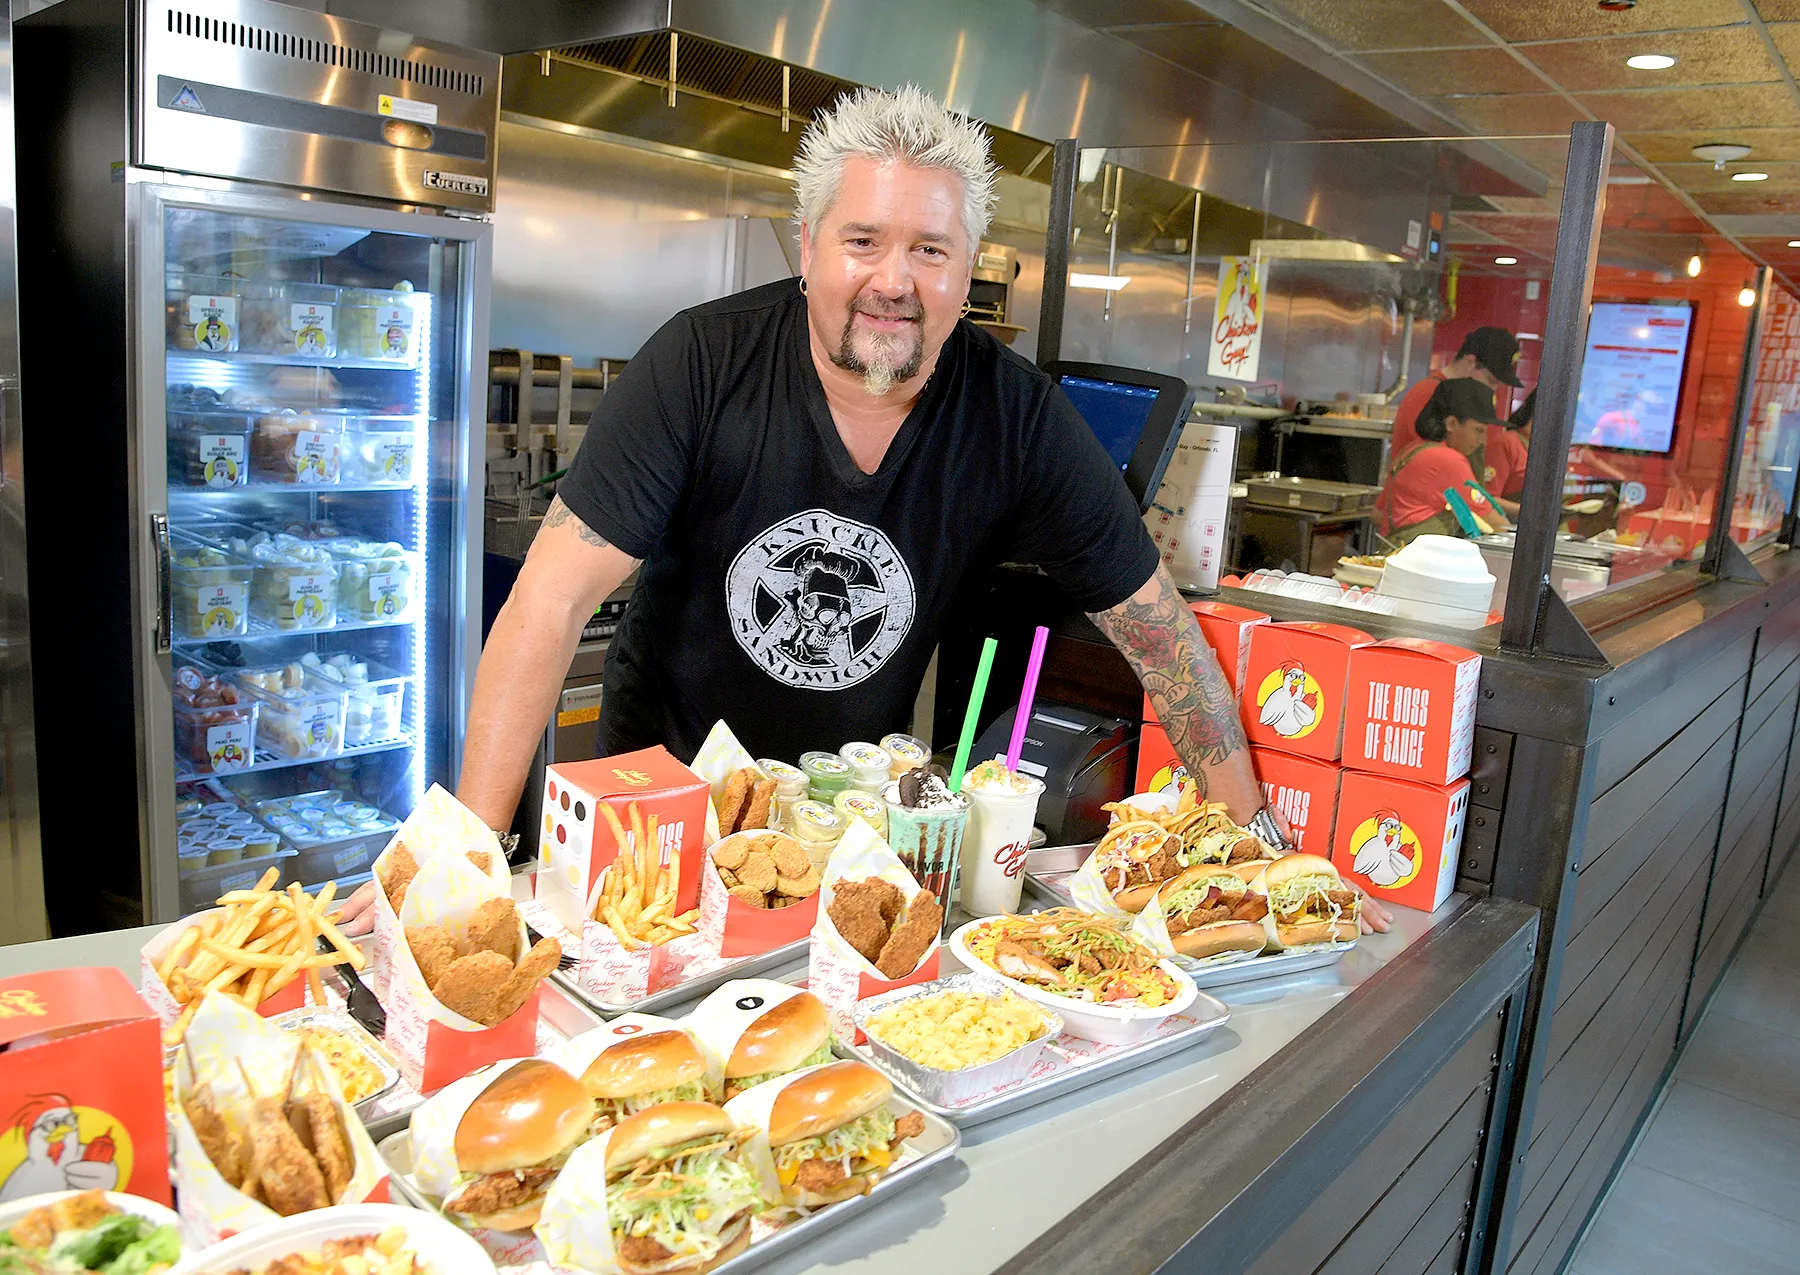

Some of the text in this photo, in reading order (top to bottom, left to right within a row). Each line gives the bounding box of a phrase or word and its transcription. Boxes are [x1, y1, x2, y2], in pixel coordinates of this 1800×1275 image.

[1215, 312, 1258, 344] Chicken
[759, 518, 899, 579] KNUCKLE
[738, 618, 883, 683] SANDWICH
[1367, 681, 1430, 727] THE BOSS
[1364, 722, 1425, 768] OF SAUCE
[587, 978, 617, 988] Chicken
[604, 961, 633, 970] Chicken
